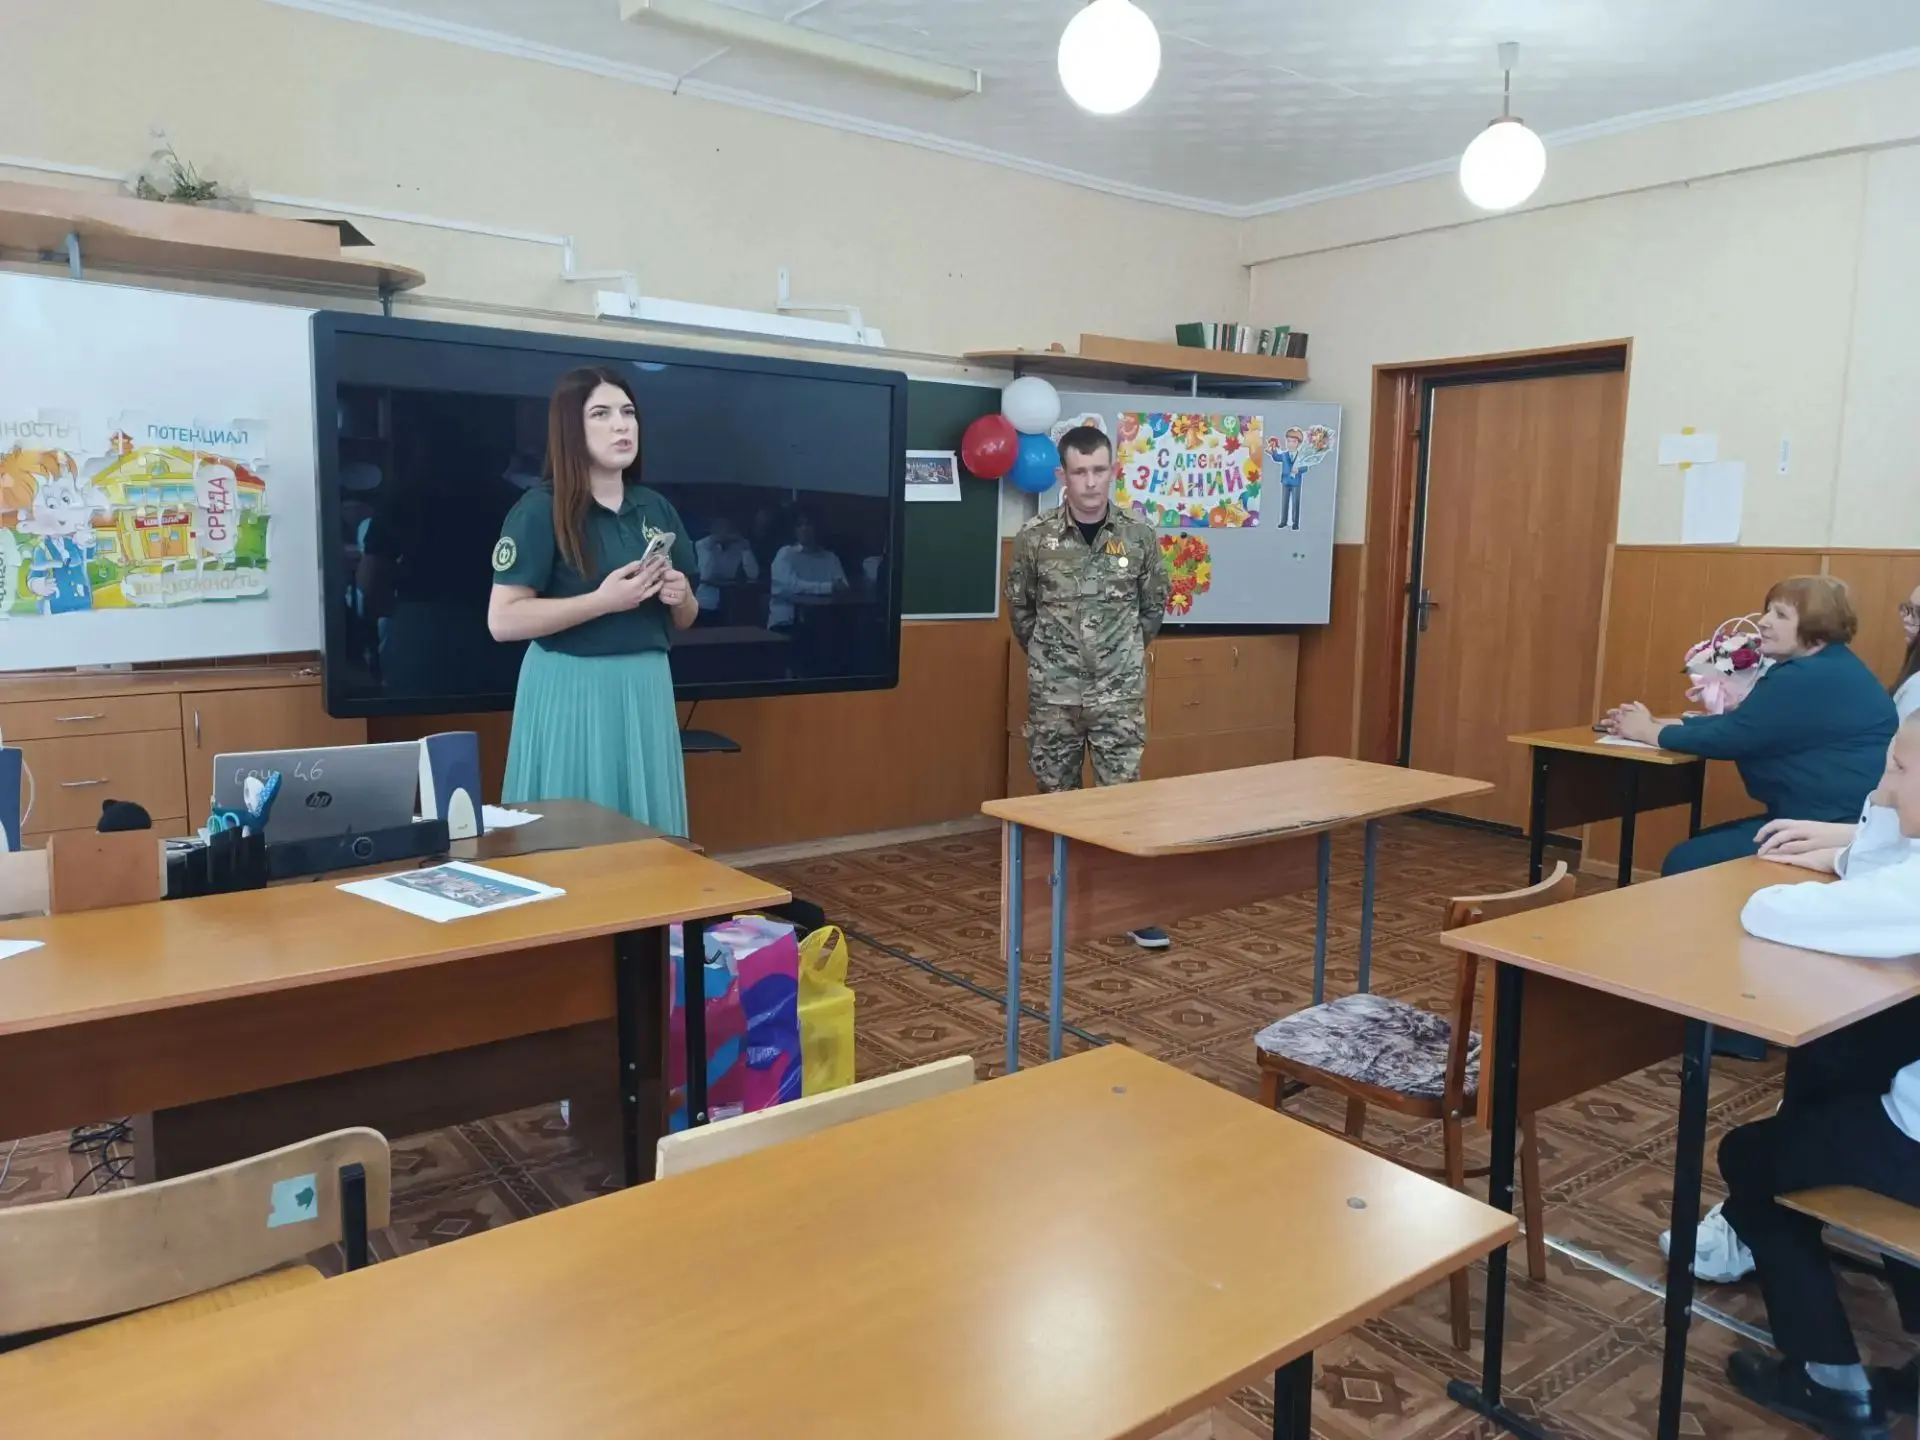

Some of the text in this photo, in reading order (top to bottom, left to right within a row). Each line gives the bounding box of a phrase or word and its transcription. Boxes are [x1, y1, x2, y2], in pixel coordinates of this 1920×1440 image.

[147, 424, 249, 446] ПОТЕНЦИАЛ
[1157, 448, 1170, 468] С
[1132, 460, 1244, 498] ЗНАНИЙ
[207, 477, 229, 541] СРЕДА
[294, 759, 326, 782] 46
[307, 791, 331, 809] hp
